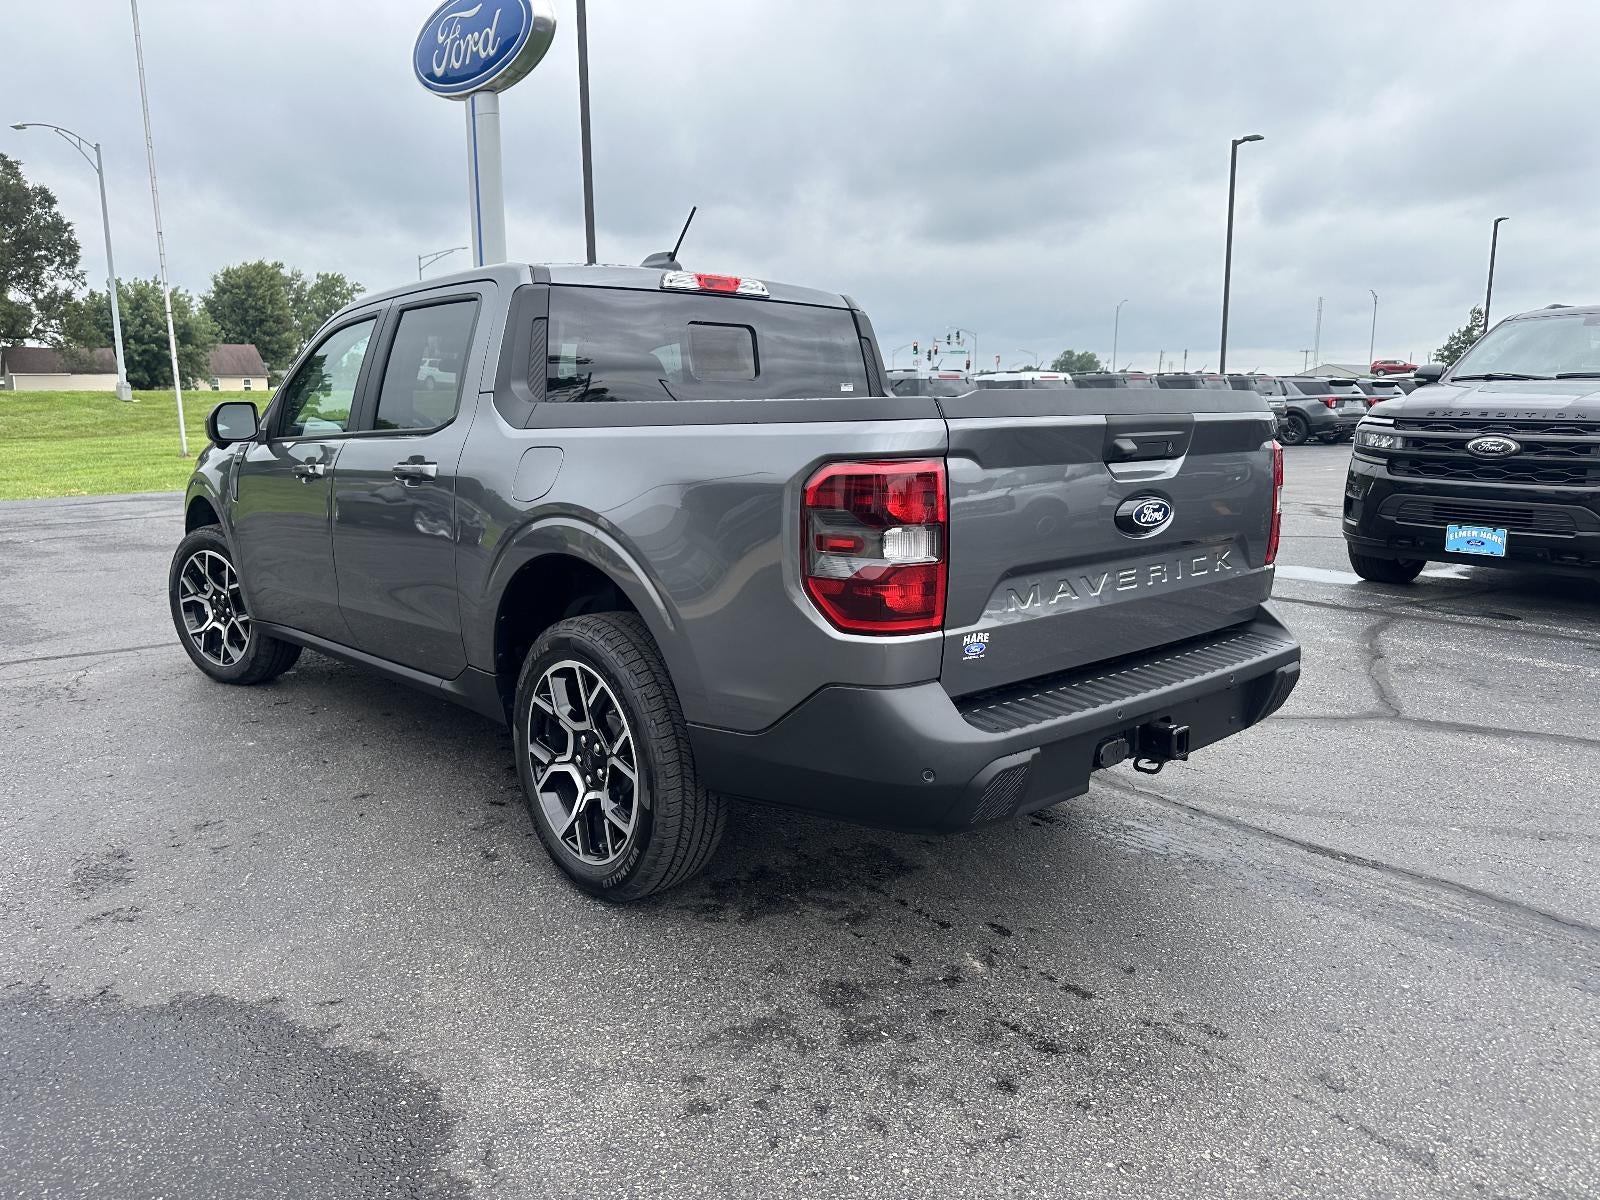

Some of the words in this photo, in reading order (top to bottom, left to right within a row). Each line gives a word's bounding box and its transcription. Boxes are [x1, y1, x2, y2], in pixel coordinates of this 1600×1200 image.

[432, 3, 501, 77] Ford
[1426, 410, 1587, 419] EXPEDITION
[1478, 441, 1505, 451] Ford
[1140, 504, 1165, 522] Ford
[1449, 530, 1478, 540] ELMER
[1479, 531, 1504, 545] HARE
[1005, 548, 1233, 613] MAVERICK
[962, 632, 990, 646] HARE
